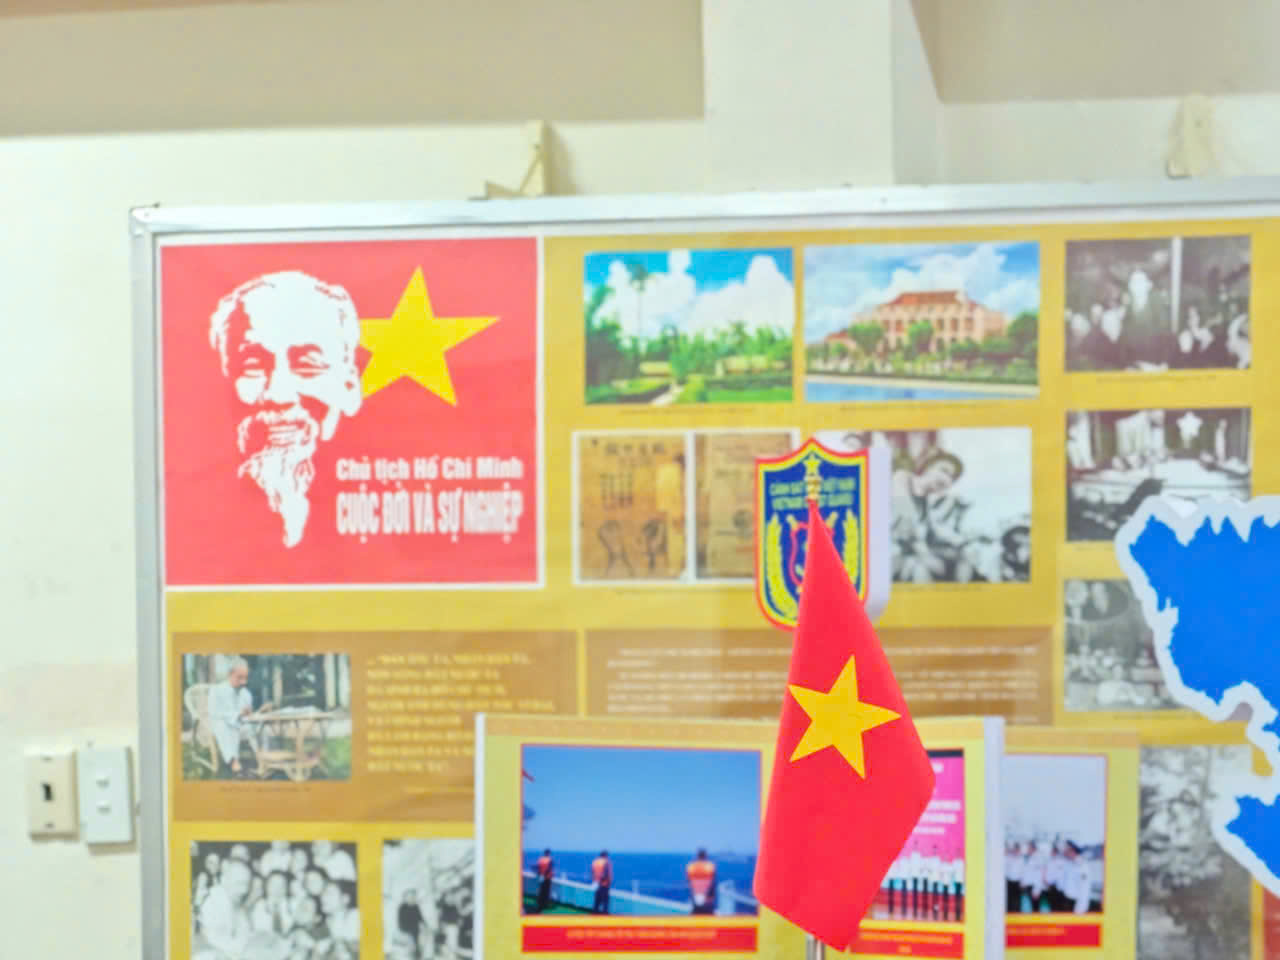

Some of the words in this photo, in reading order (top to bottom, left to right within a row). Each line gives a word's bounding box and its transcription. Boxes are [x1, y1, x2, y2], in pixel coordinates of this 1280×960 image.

[413, 454, 439, 480] Hồ
[441, 456, 472, 480] Chí
[476, 456, 523, 480] Minh
